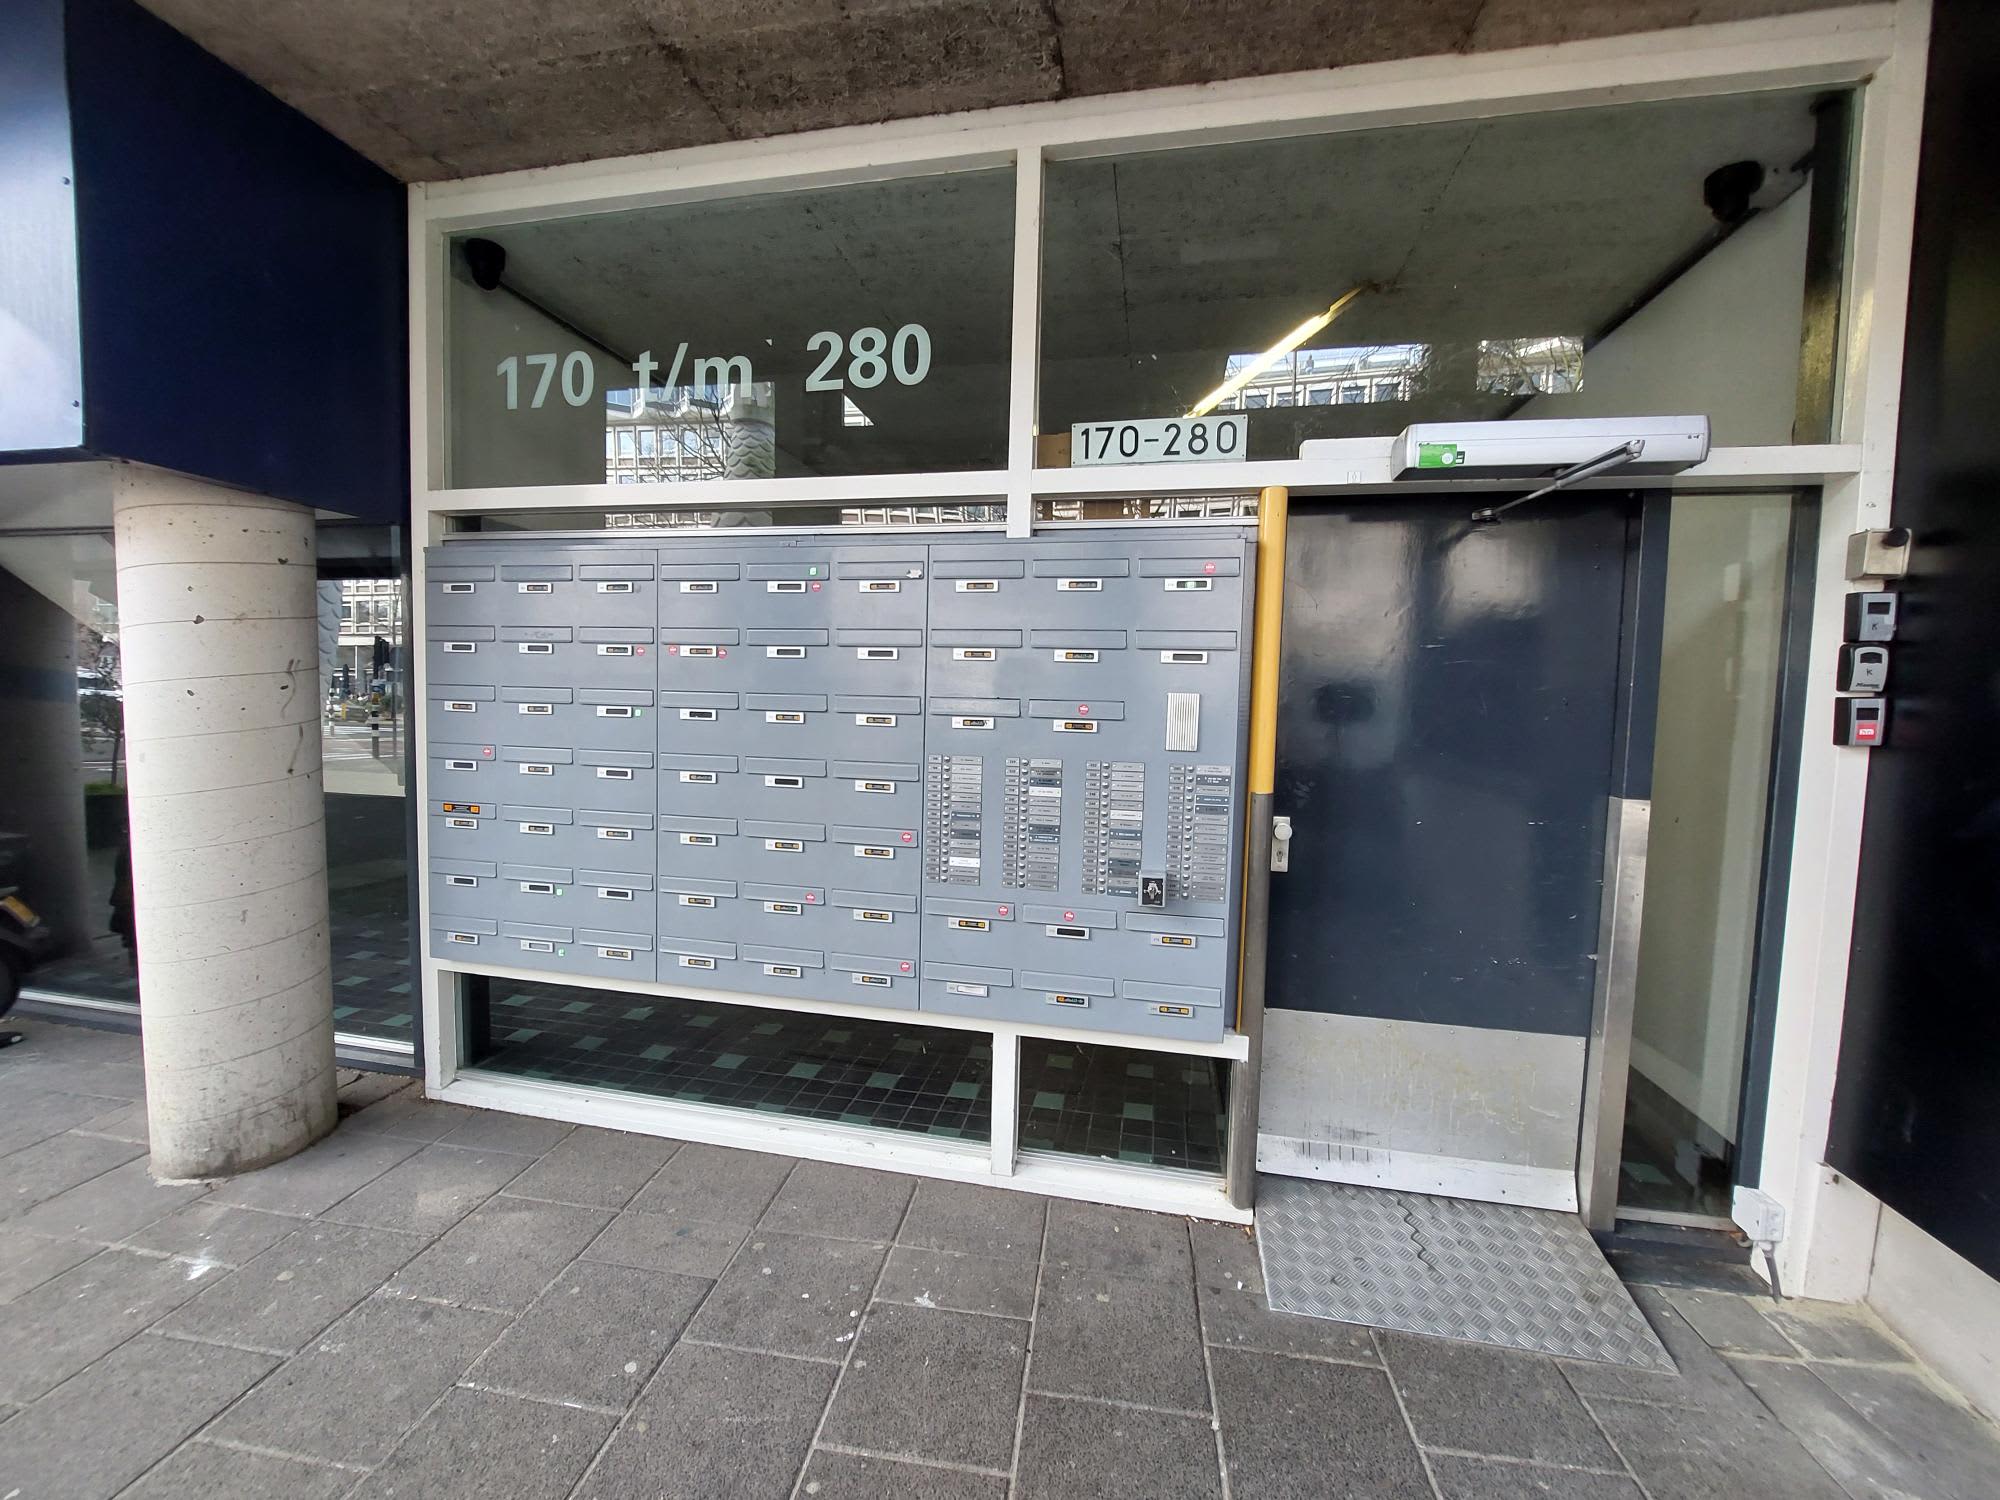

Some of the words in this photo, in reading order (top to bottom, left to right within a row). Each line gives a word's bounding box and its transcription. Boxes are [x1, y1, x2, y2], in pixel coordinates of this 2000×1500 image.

[496, 350, 595, 410] 170
[632, 342, 752, 402] t/m
[805, 323, 932, 392] 280
[1080, 420, 1238, 460] 170-280
